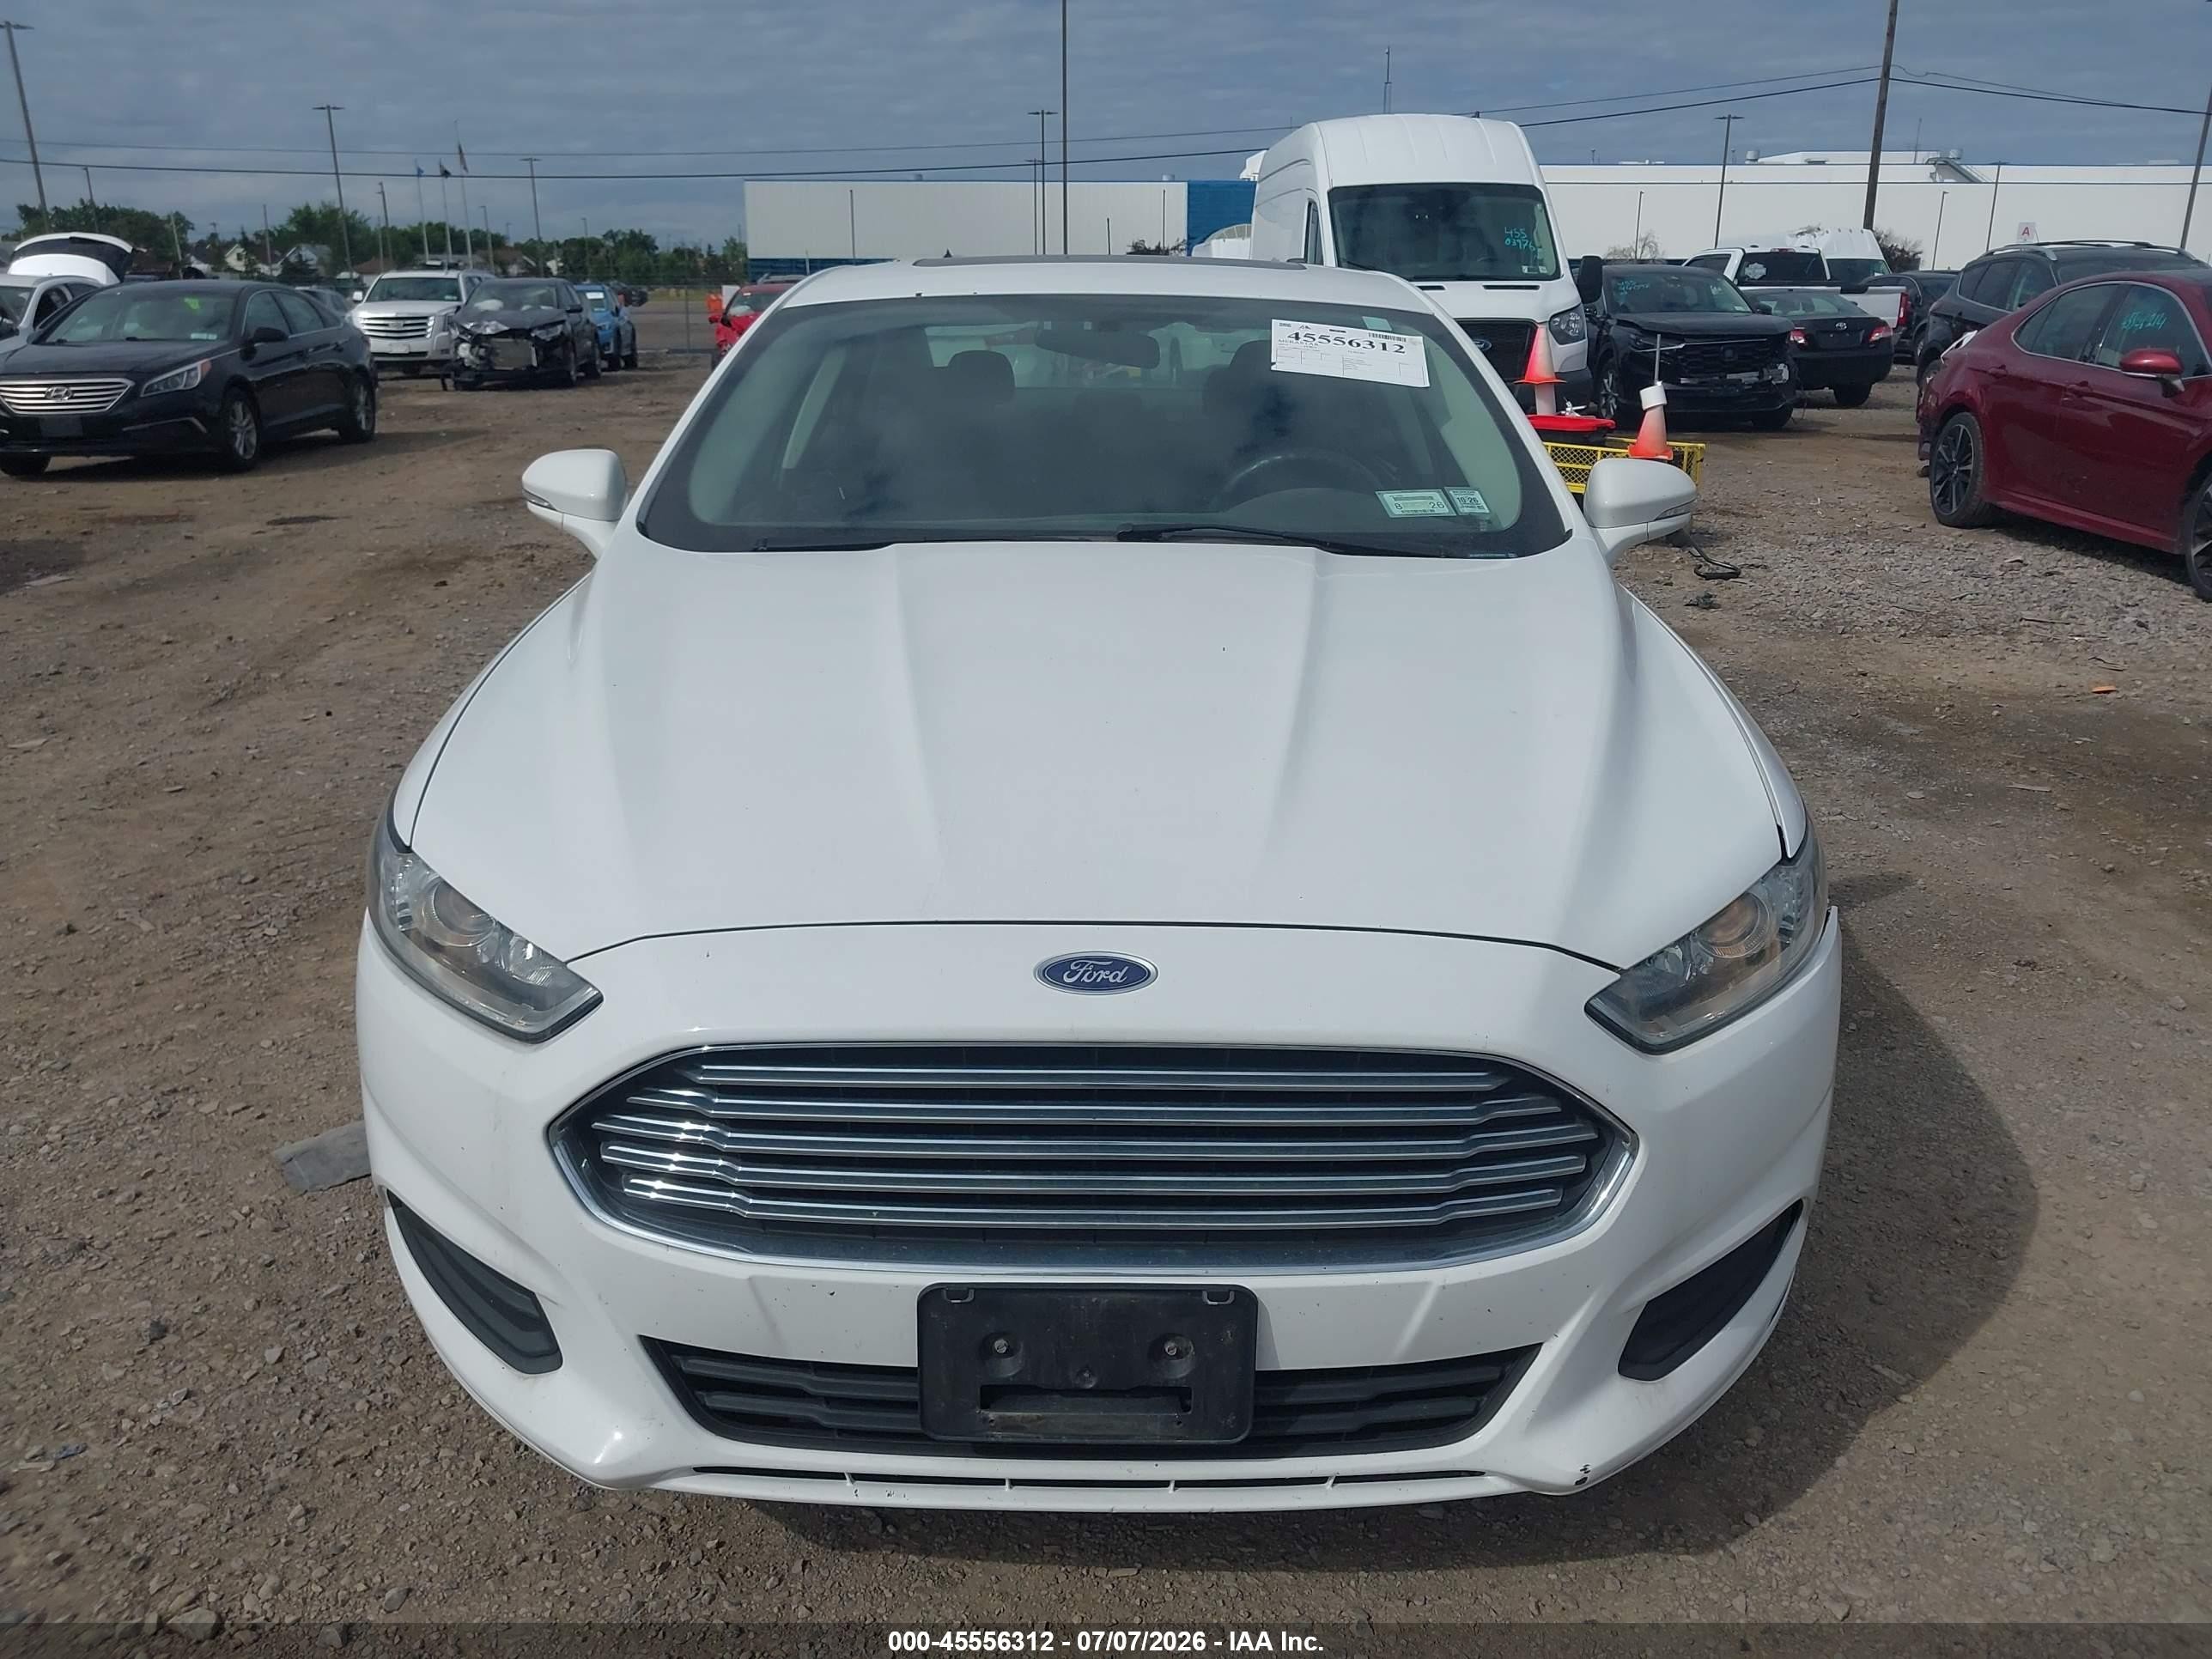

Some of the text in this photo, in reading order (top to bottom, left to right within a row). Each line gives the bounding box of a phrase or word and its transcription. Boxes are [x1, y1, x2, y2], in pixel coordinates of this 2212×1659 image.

[2021, 227, 2030, 236] A
[1287, 331, 1406, 354] 45556312
[1063, 960, 1128, 983] Ford
